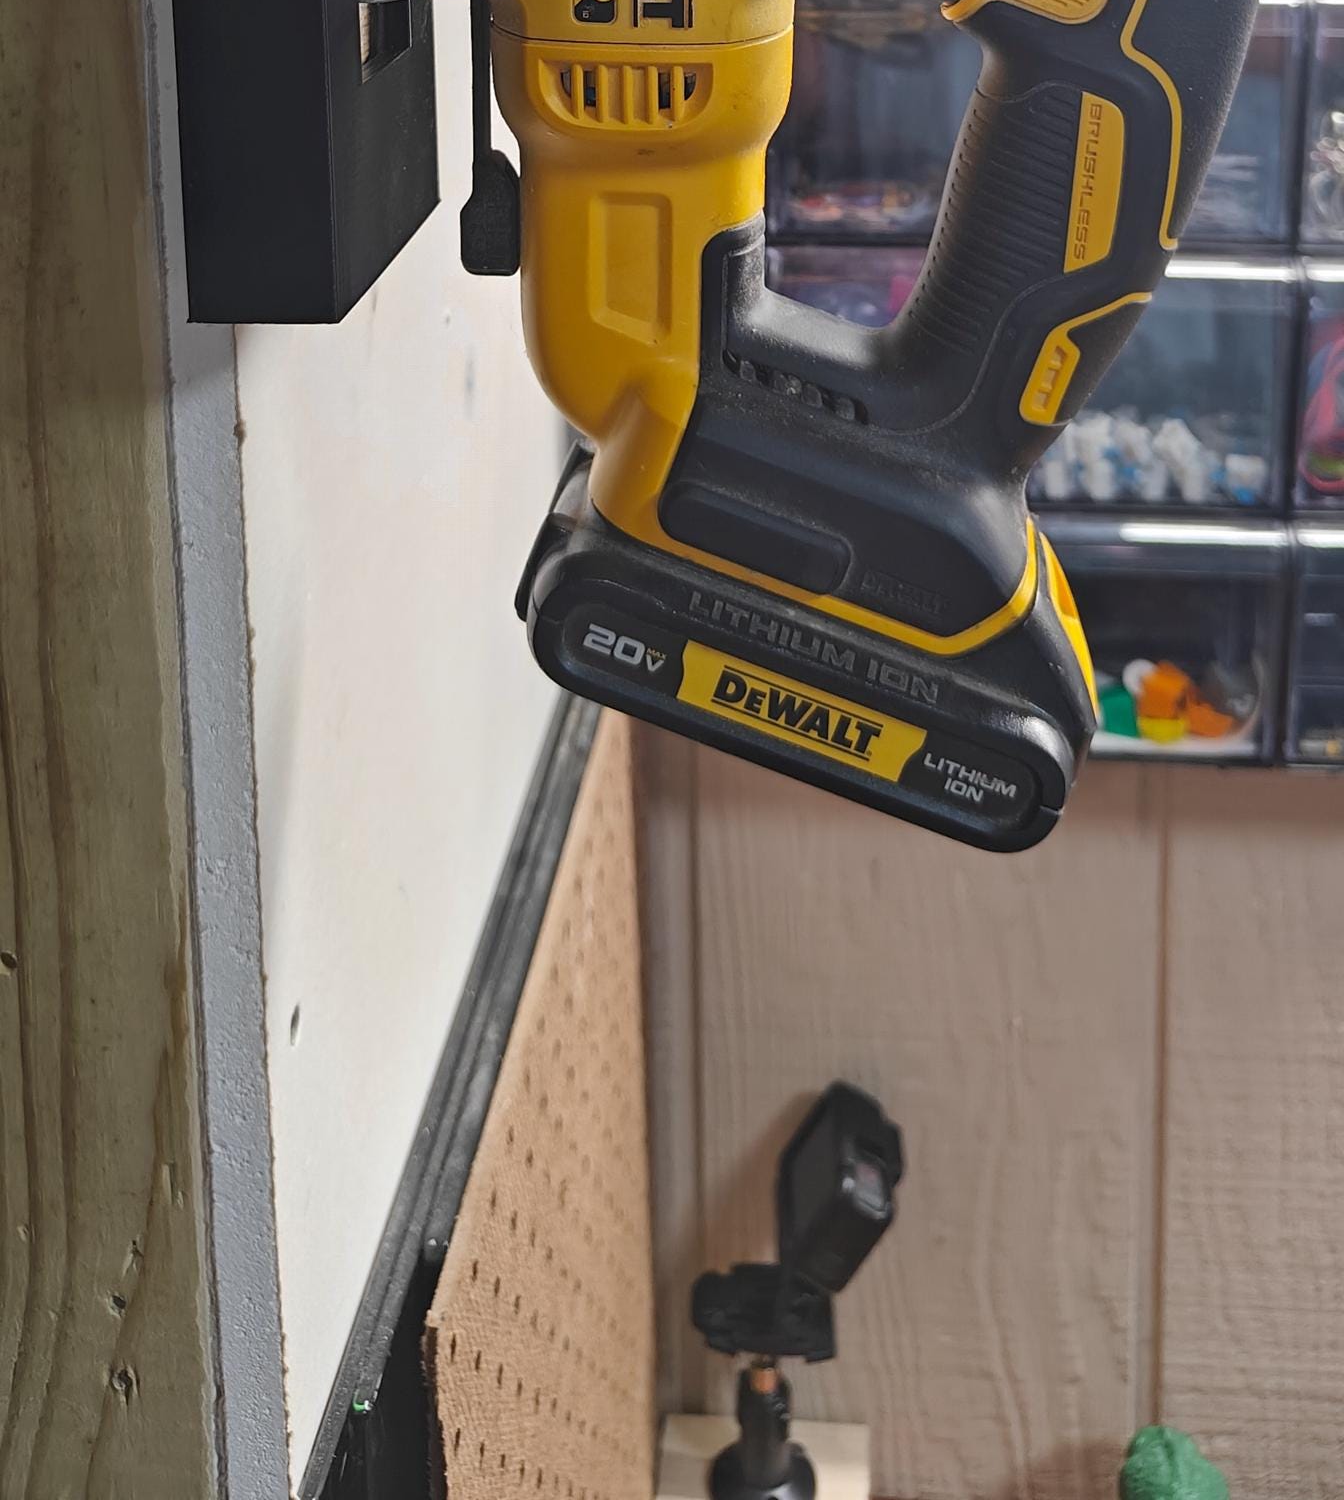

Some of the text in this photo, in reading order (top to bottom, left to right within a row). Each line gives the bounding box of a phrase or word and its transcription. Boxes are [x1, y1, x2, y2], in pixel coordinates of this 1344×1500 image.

[1073, 102, 1103, 261] BRUSHLESS
[688, 590, 939, 705] LITHIUM ION
[923, 752, 1018, 799] LITHIUM
[944, 776, 985, 804] ION
